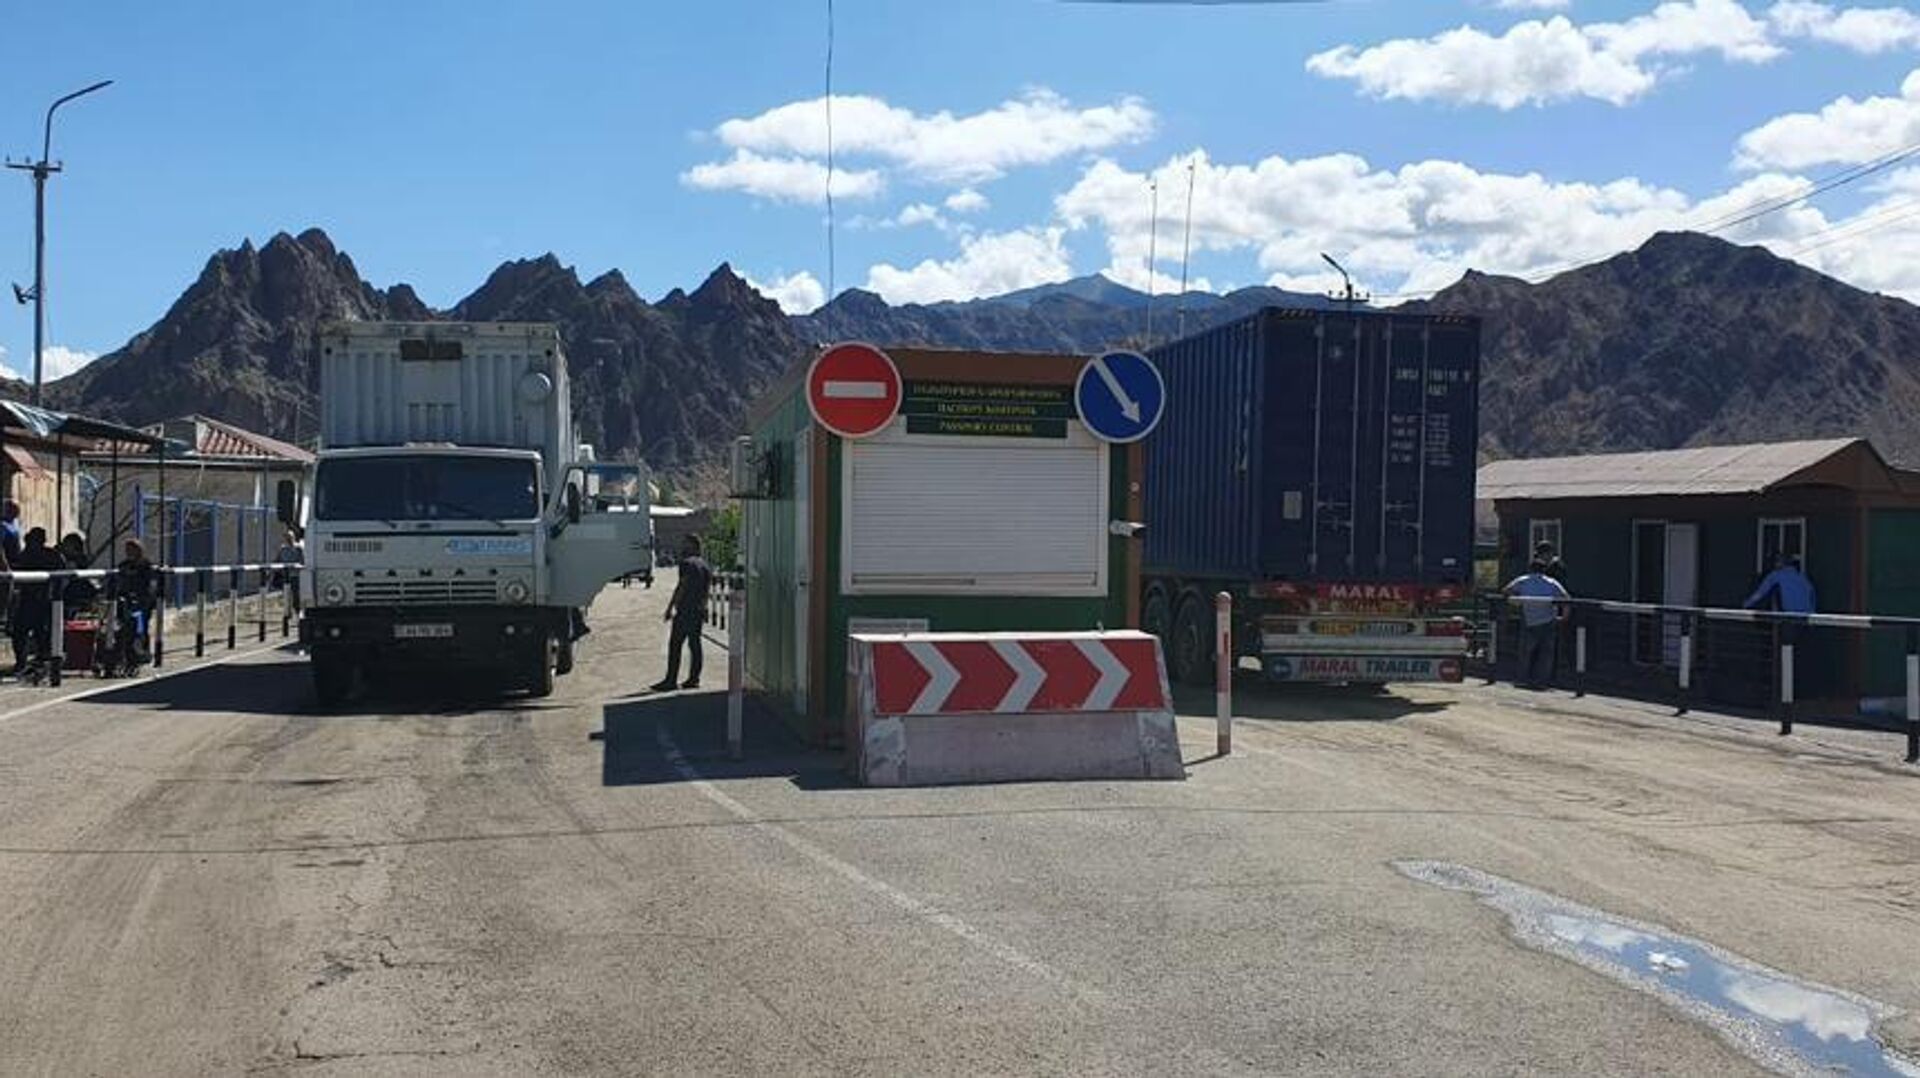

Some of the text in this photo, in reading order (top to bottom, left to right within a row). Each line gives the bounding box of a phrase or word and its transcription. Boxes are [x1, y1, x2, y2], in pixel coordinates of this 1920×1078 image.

[1330, 584, 1401, 600] MARAL
[1301, 658, 1431, 675] MARAL TRAILER
